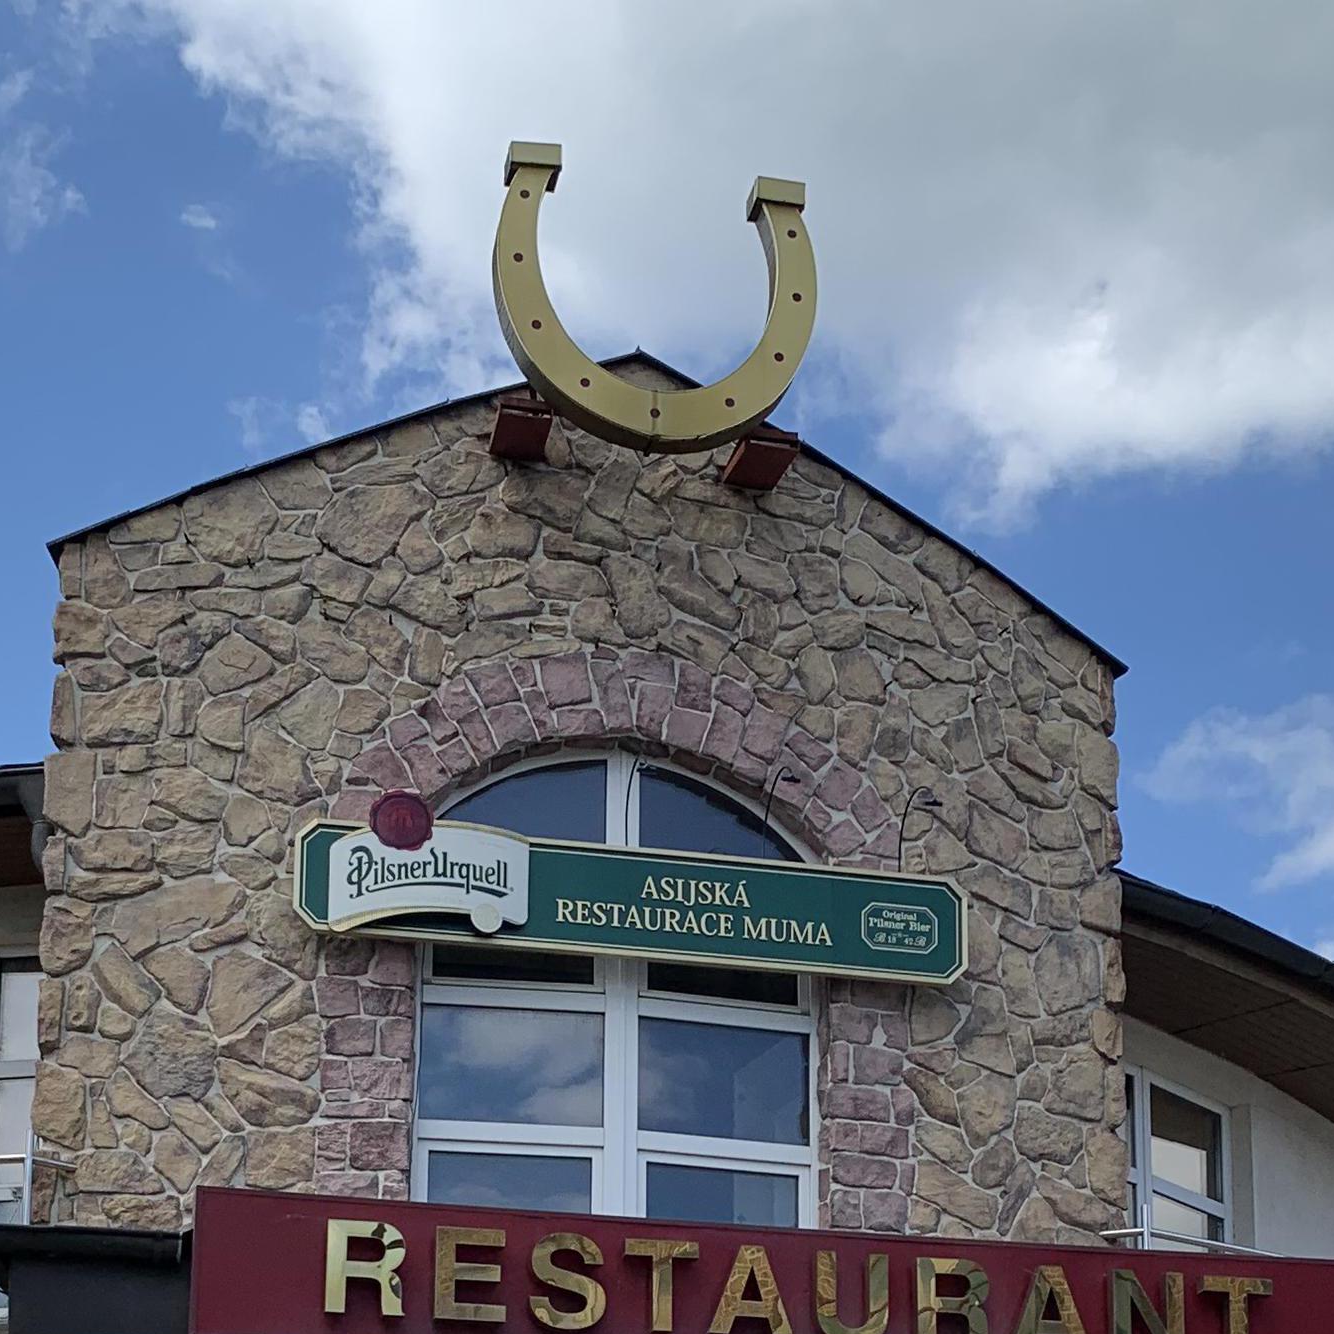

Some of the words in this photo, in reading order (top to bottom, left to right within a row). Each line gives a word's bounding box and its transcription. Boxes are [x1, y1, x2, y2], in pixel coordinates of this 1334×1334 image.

[347, 845, 433, 899] Pilsner
[429, 847, 509, 895] Urquell
[640, 875, 751, 907] ASIJSKÁ
[555, 898, 734, 938] RESTAURACE
[742, 915, 834, 947] MUMA
[868, 917, 906, 930] Pilsner
[909, 921, 931, 932] Bier
[882, 910, 917, 921] Original
